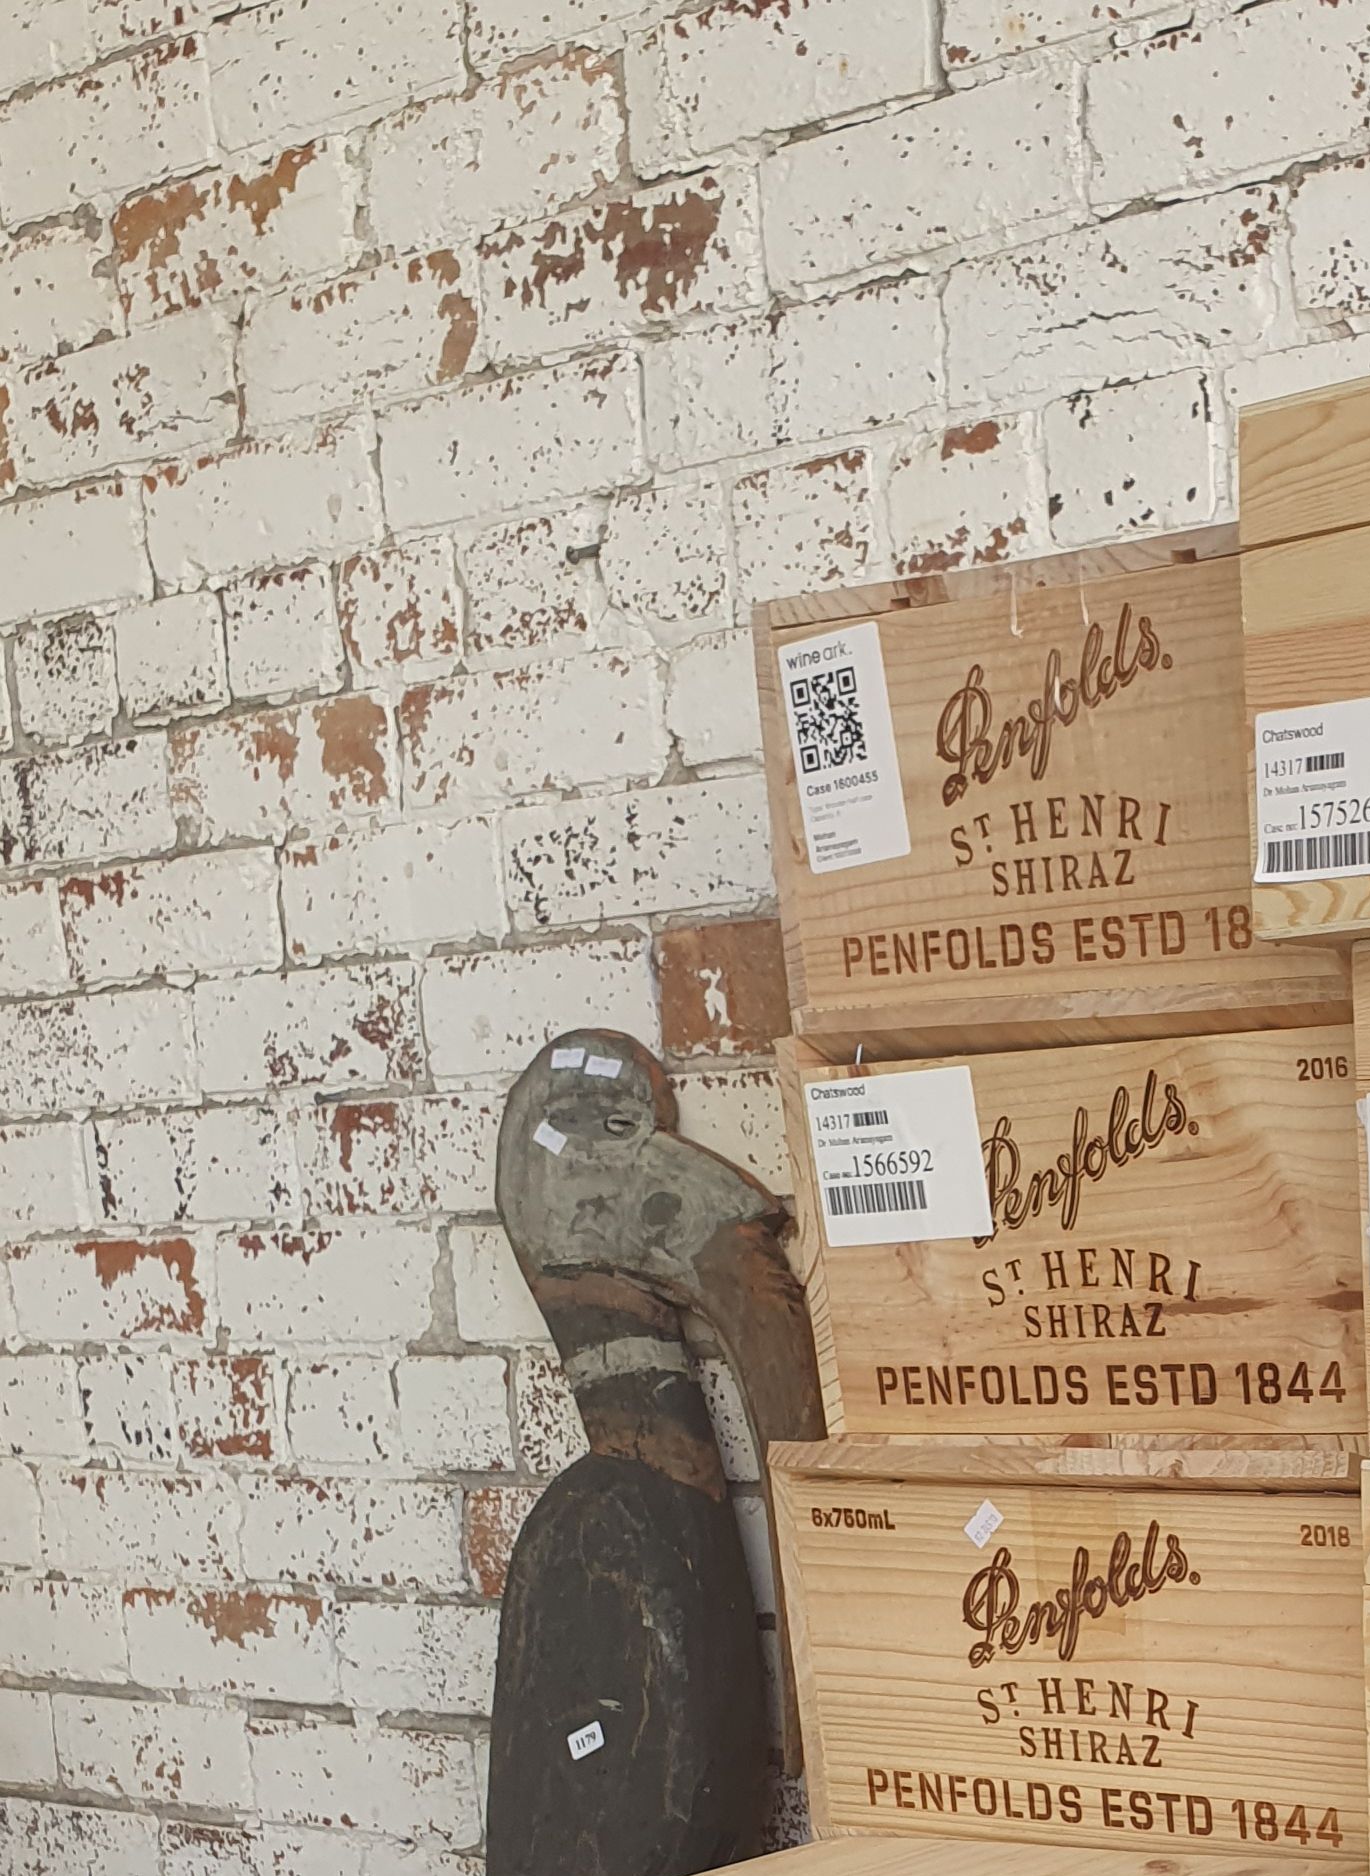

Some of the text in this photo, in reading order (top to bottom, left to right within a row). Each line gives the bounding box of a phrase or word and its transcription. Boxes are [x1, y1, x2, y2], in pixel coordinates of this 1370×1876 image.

[786, 648, 820, 670] wine
[1262, 722, 1323, 744] Chatswood
[1265, 757, 1302, 778] 14317
[806, 783, 831, 797] Case
[1010, 792, 1172, 848] HENRI
[991, 848, 1136, 897] SHIRAZ
[842, 904, 1254, 978] PENFOLDS ESTD 18
[1297, 1056, 1348, 1082] 2016
[815, 1113, 850, 1131] 14317
[853, 1149, 934, 1178] 1566592
[1041, 1247, 1202, 1303] HENRI
[1024, 1302, 1167, 1339] SHIRAZ
[876, 1360, 1347, 1406] PENFOLDS ESTD 1844
[1300, 1525, 1351, 1548] 2018
[1036, 1677, 1200, 1739] HENRI
[1019, 1727, 1163, 1768] SHIRAZ
[866, 1768, 1344, 1848] PENFOLDS ESTD 1844
